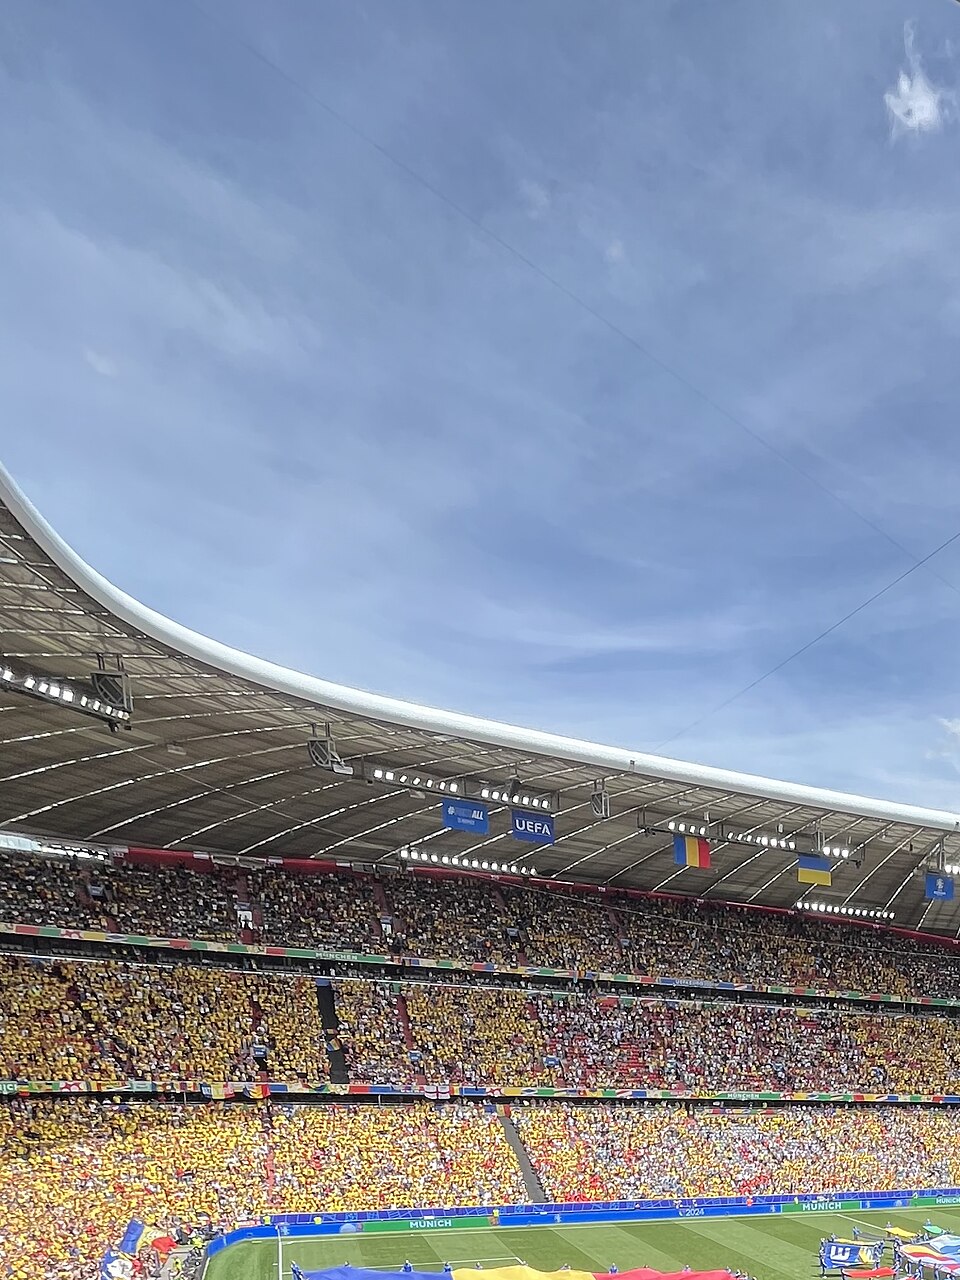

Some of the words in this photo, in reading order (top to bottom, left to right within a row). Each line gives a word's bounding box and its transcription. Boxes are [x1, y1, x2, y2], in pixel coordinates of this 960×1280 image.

[515, 819, 551, 835] UEFA
[803, 1201, 842, 1211] MUNICH
[685, 1208, 705, 1217] 2024
[409, 1219, 452, 1229] MUNICH
